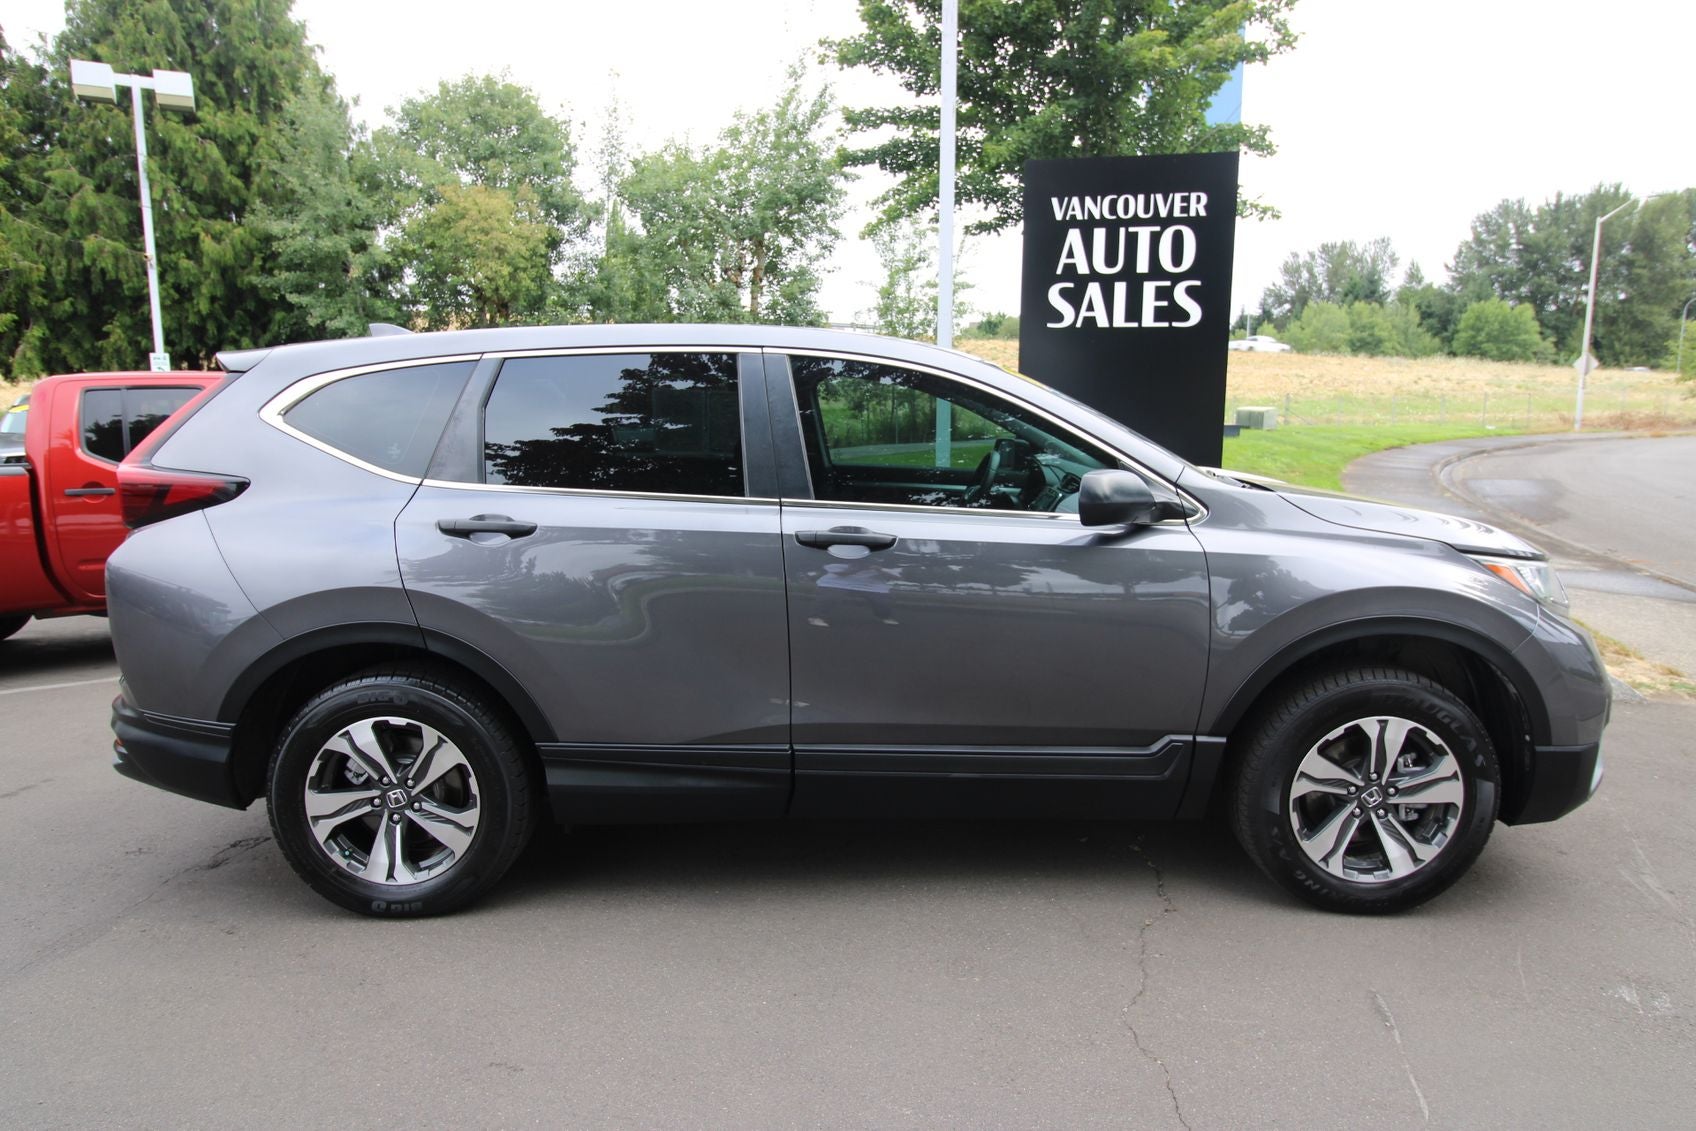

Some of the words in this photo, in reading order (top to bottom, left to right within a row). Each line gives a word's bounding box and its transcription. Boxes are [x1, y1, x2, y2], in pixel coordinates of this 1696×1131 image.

[1050, 191, 1208, 221] VANCOUVER
[1055, 224, 1197, 275] AUTO
[1046, 279, 1203, 328] SALES
